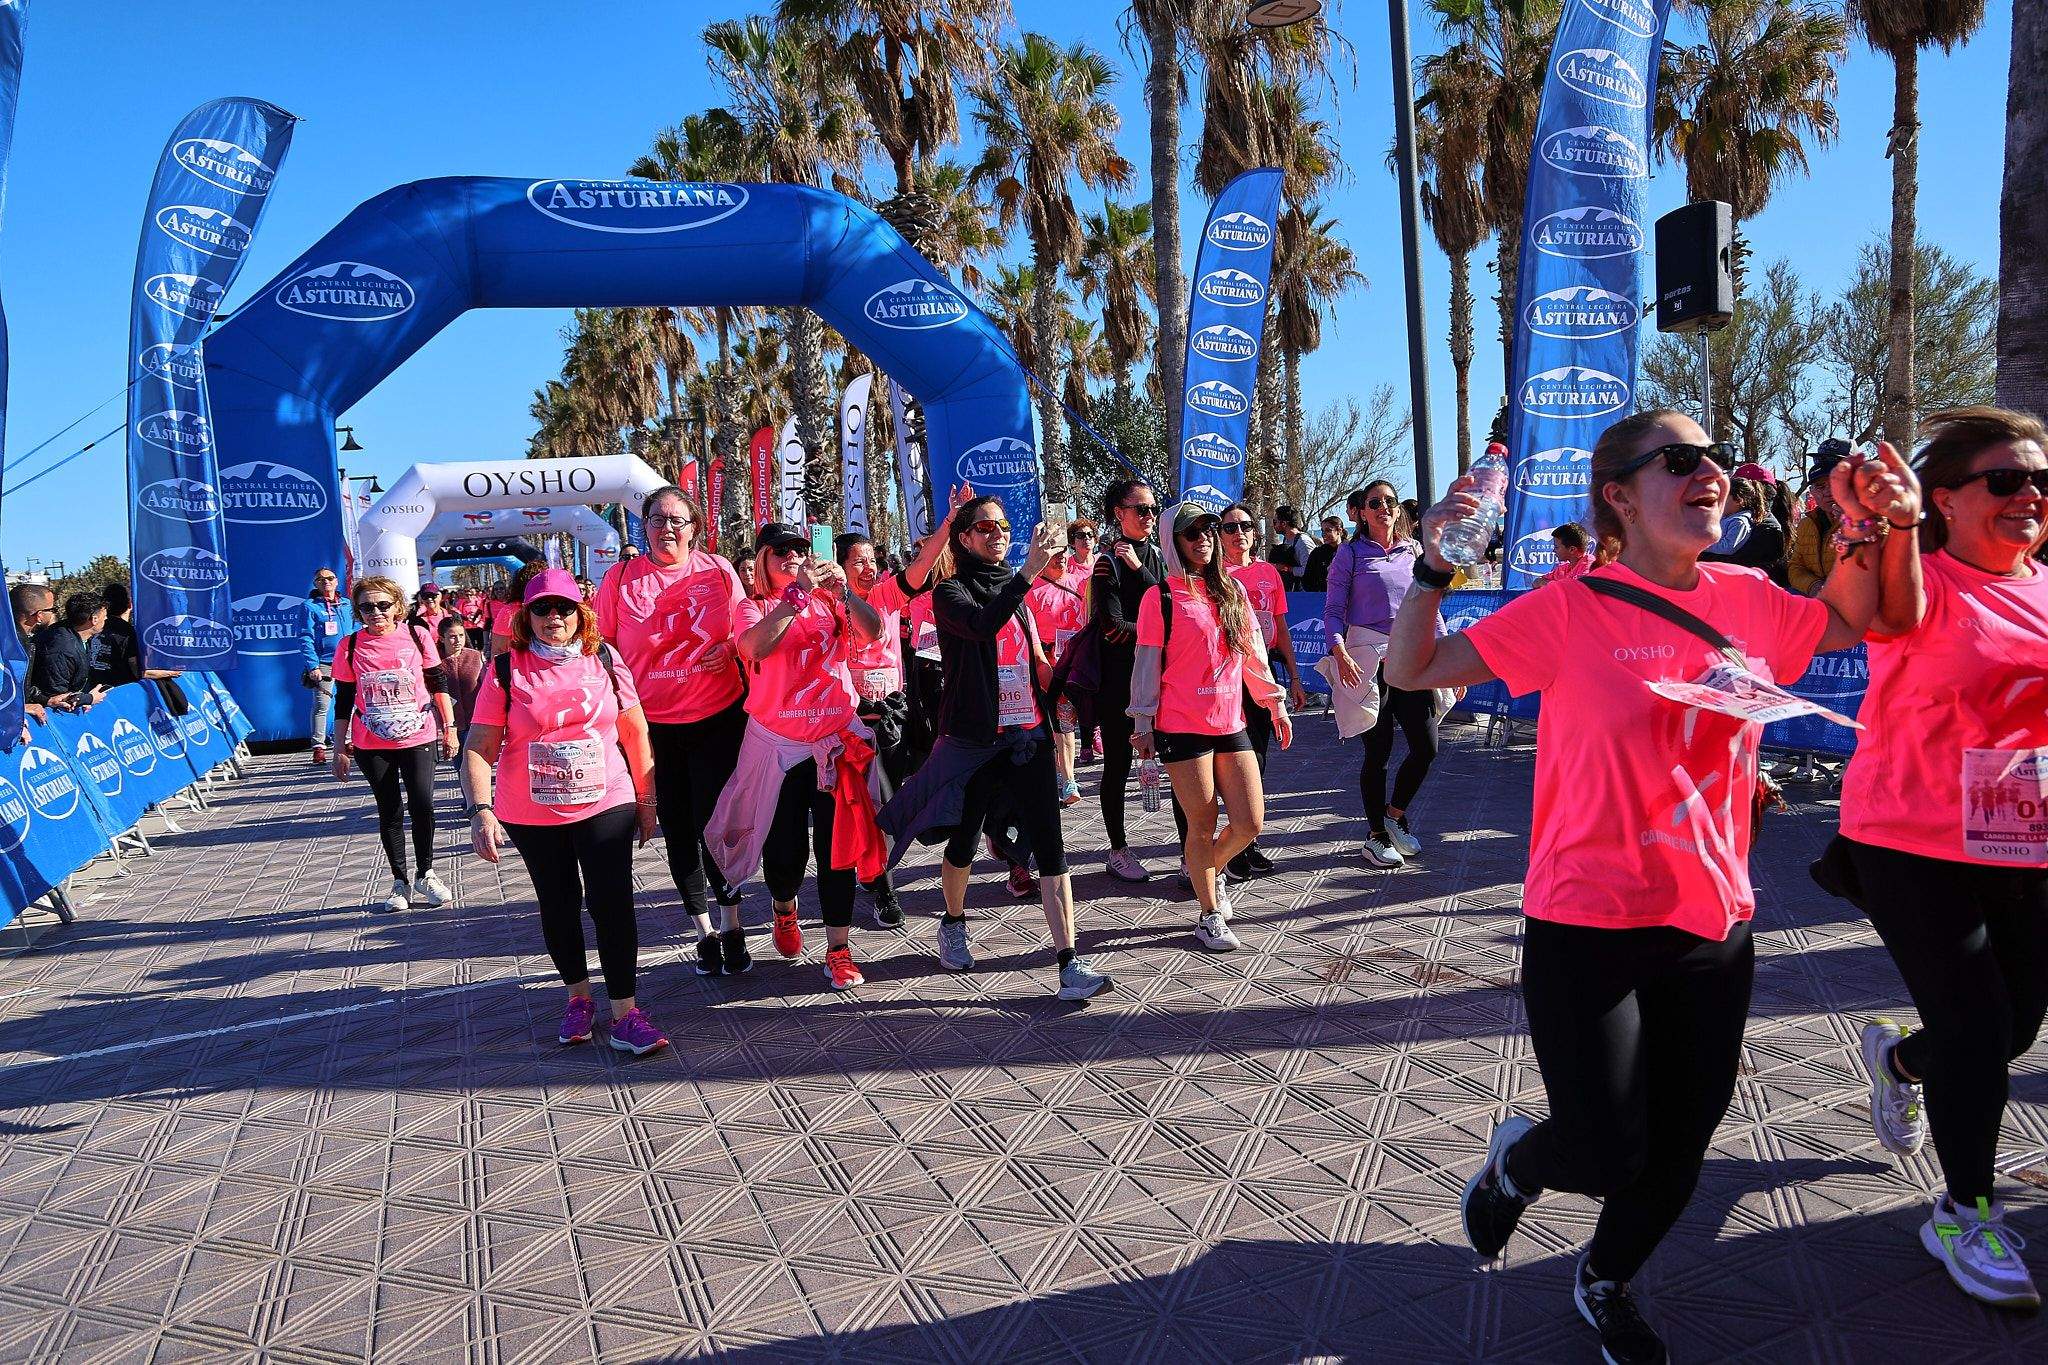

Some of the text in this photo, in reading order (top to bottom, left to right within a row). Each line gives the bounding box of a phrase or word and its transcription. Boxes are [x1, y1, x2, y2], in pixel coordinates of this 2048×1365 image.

[1548, 140, 1639, 173] ASTURIANA
[547, 183, 736, 209] ASTURIANA
[1211, 224, 1266, 243] ASTURIANA
[1537, 224, 1637, 247] ASTURIANA
[307, 281, 401, 290] CENTRAL LECHERA
[1202, 280, 1259, 300] ASTURIANA
[286, 284, 405, 309] ASTURIANA
[874, 300, 963, 318] ASTURIANA
[1530, 305, 1629, 326] ASTURIANA
[1196, 335, 1252, 356] ASTURIANA
[1191, 390, 1242, 411] ASTURIANA
[1524, 386, 1620, 405] ASTURIANA
[1187, 443, 1237, 464] ASTURIANA
[464, 467, 596, 498] OYSHO
[757, 447, 769, 515] Santander
[785, 438, 804, 527] YSHO
[1518, 467, 1591, 486] ASTURIA
[273, 482, 316, 491] LECHERA
[222, 492, 321, 510] STURIANA
[711, 471, 724, 527] Santander
[382, 505, 424, 514] OYSHO
[440, 542, 507, 553] VOLVO
[367, 558, 408, 568] OYSHO
[232, 614, 279, 622] CENTRAL
[151, 629, 230, 648] ASTURIANA
[1291, 640, 1328, 655] STURIAN
[1614, 644, 1675, 662] OYSHO
[1000, 691, 1021, 702] 016
[778, 709, 807, 718] CARRERA
[557, 769, 584, 780] 016
[2017, 800, 2048, 820] 01
[1983, 833, 2016, 841] CARRERA
[1981, 844, 2030, 855] OYSHO
